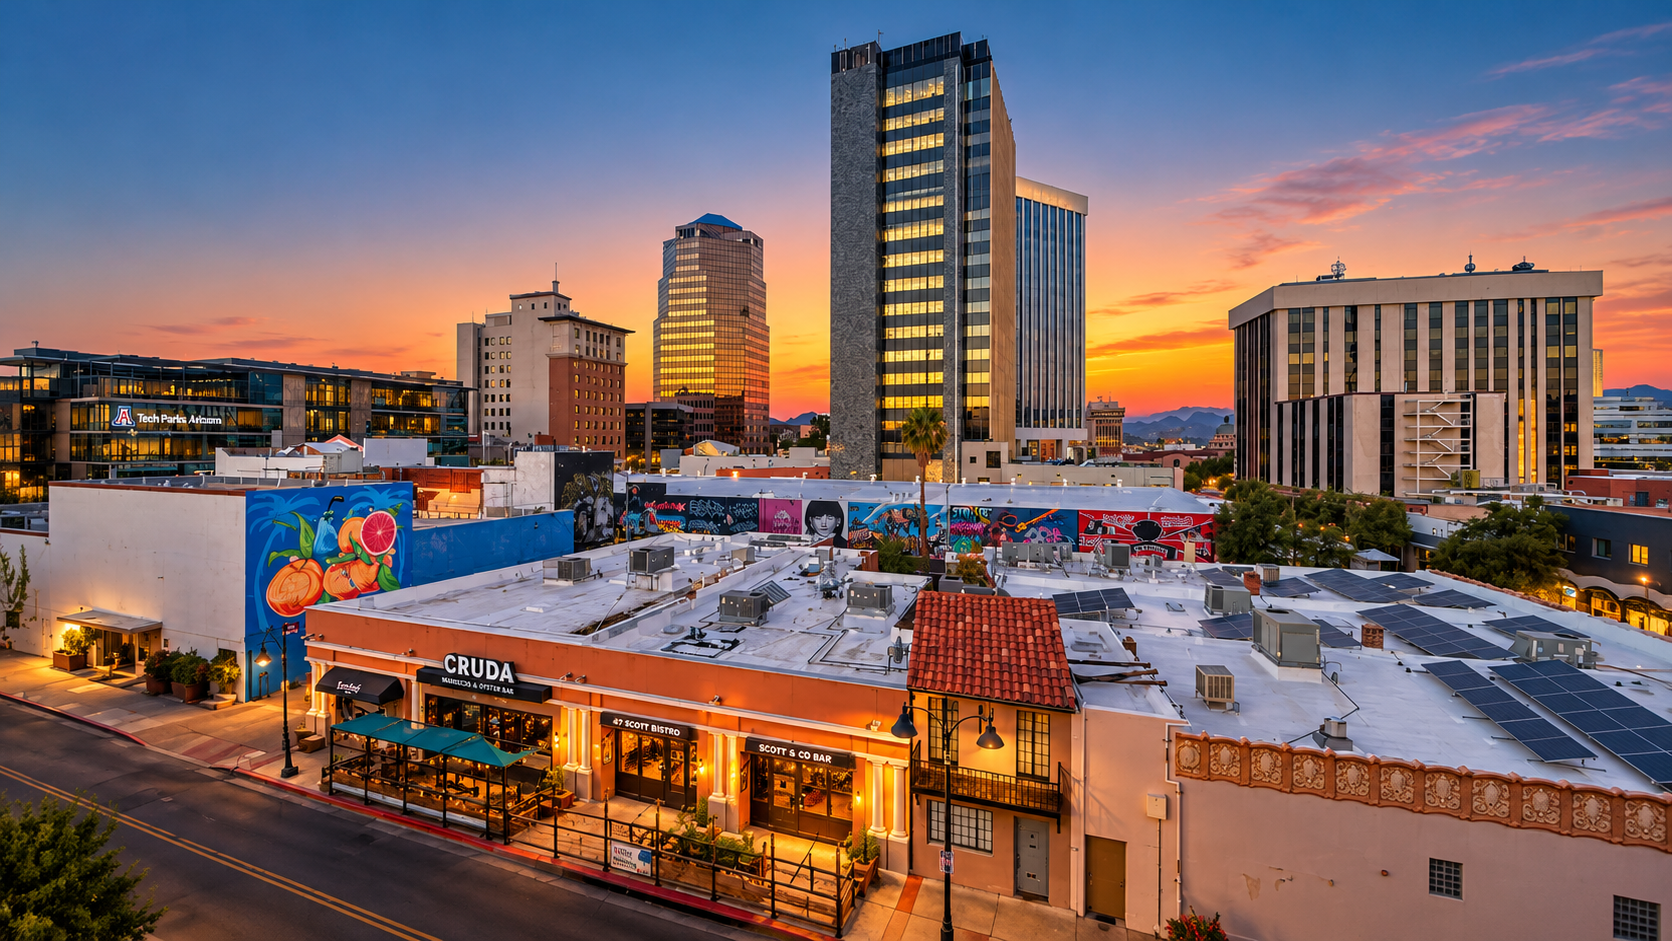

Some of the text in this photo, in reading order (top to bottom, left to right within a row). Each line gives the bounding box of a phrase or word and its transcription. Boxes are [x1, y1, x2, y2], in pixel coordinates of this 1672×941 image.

[137, 413, 159, 424] Tech
[444, 654, 514, 684] CRUDA
[479, 682, 501, 693] OYSTER
[501, 686, 514, 695] BAR
[612, 717, 680, 736] 47 SCOTT BISTRO
[759, 743, 787, 756] SCOTT
[798, 750, 811, 760] CO
[813, 752, 832, 764] BAR
